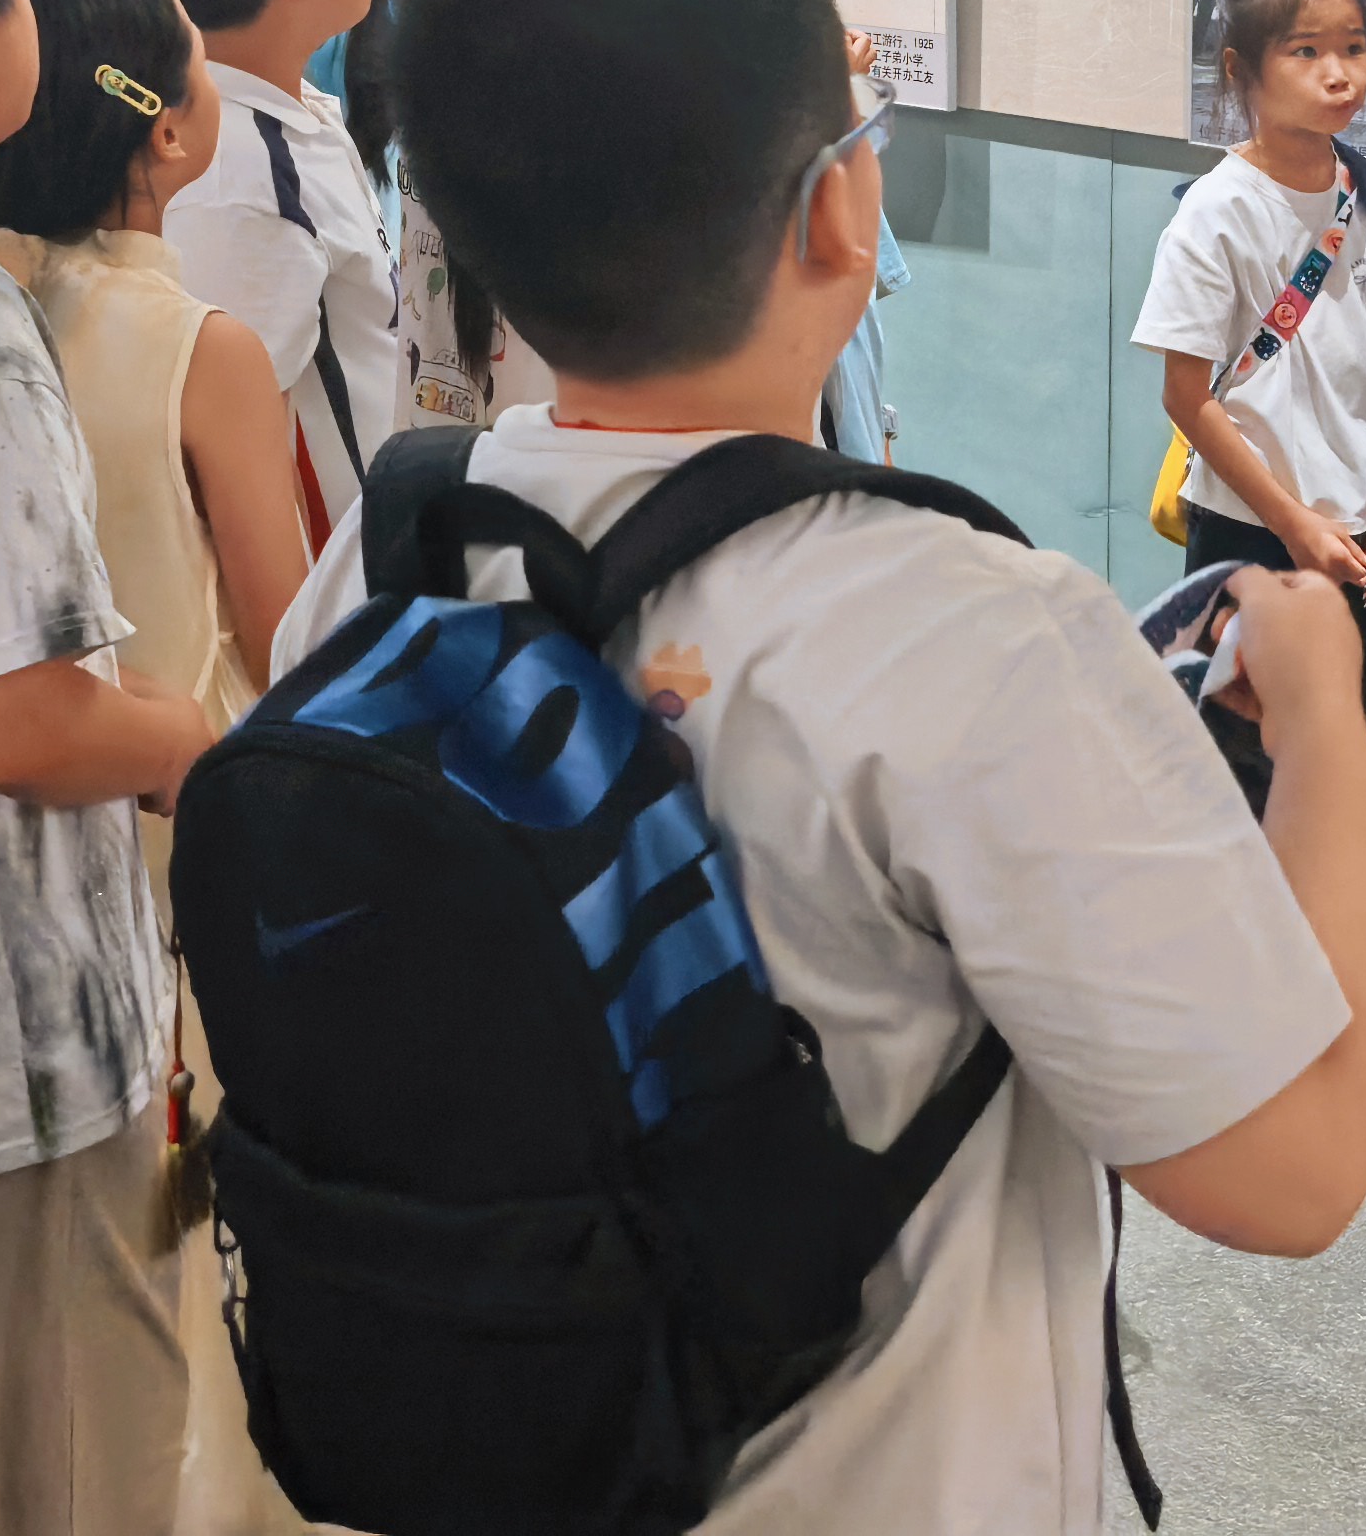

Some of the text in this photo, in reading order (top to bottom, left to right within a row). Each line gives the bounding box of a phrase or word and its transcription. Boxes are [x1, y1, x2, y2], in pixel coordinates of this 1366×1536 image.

[864, 32, 934, 49] 工游行。1925
[871, 65, 934, 85] 有关开办工友
